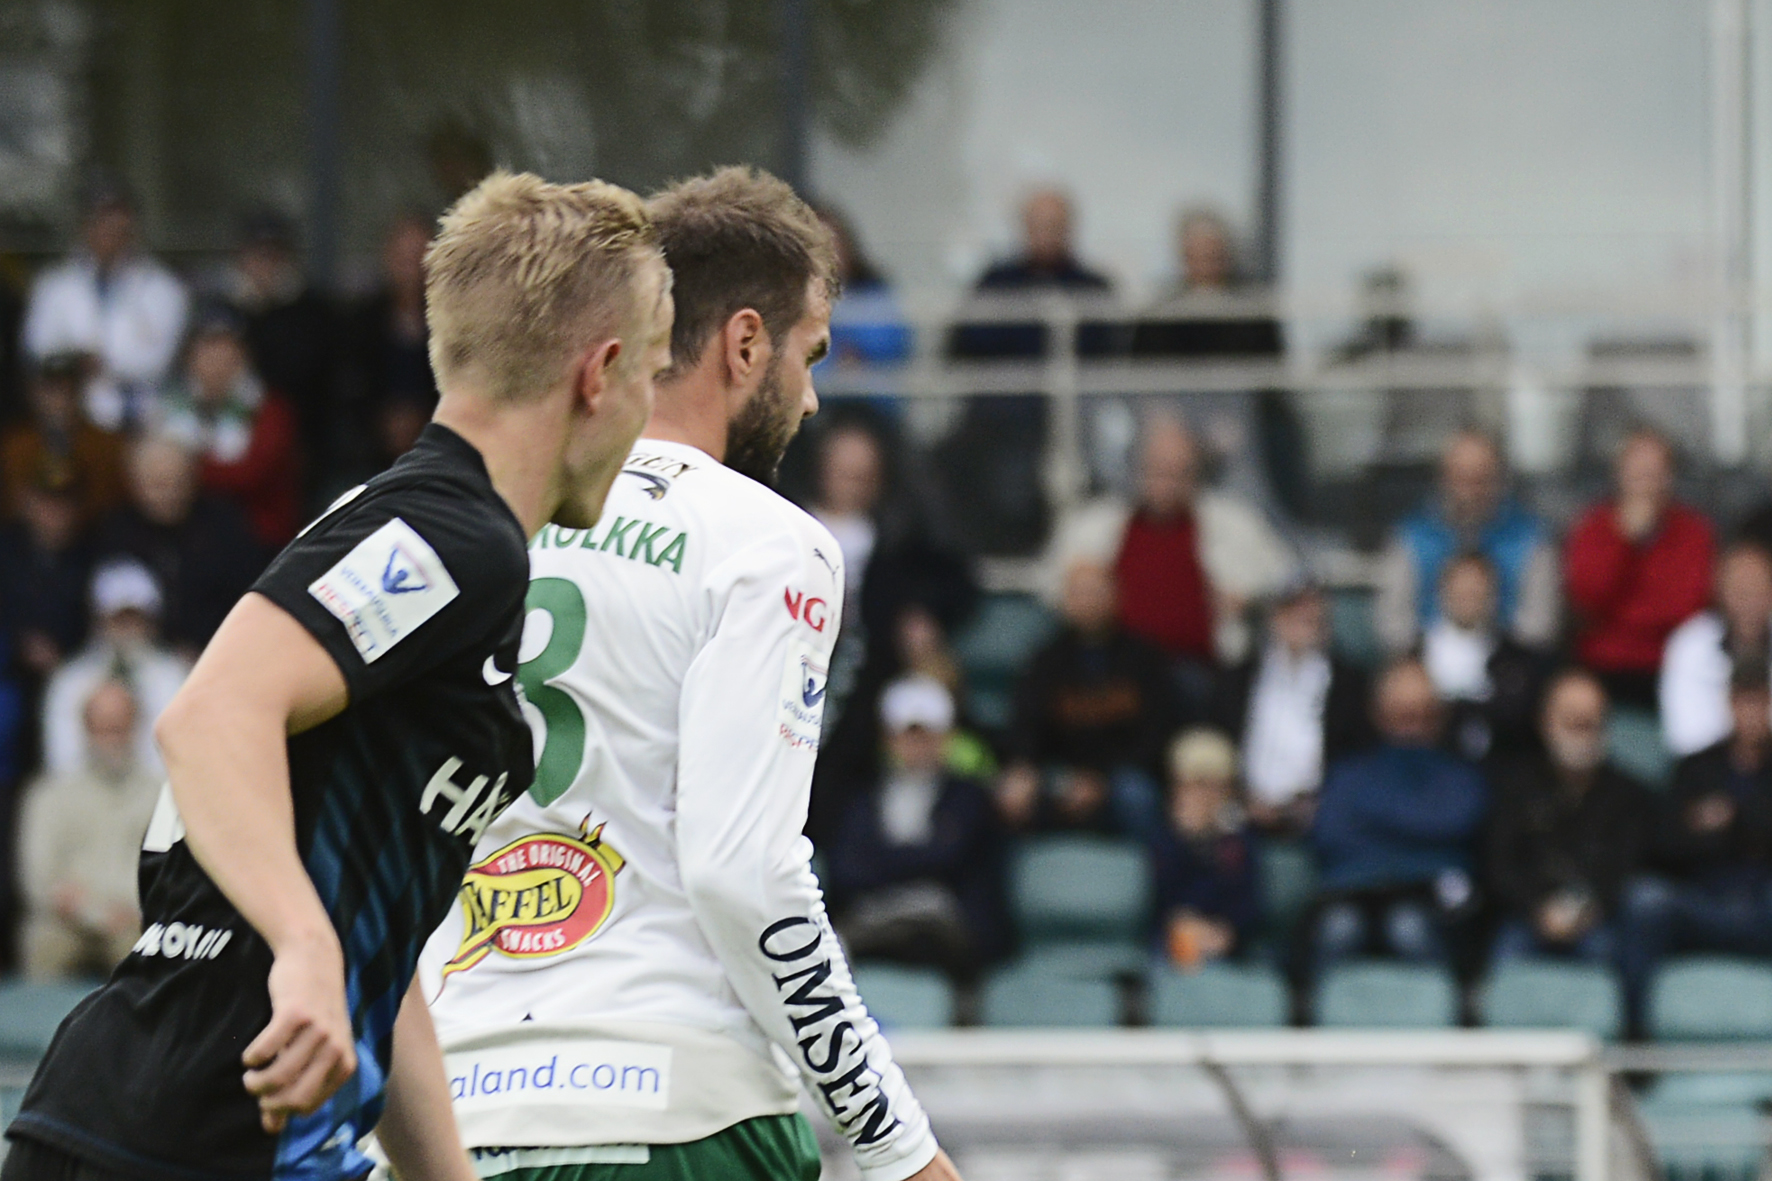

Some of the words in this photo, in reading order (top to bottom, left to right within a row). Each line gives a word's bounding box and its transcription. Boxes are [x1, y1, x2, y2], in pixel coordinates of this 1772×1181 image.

[497, 848, 527, 874] THE
[528, 844, 602, 888] ORIGINAL
[500, 928, 566, 952] SNACKS
